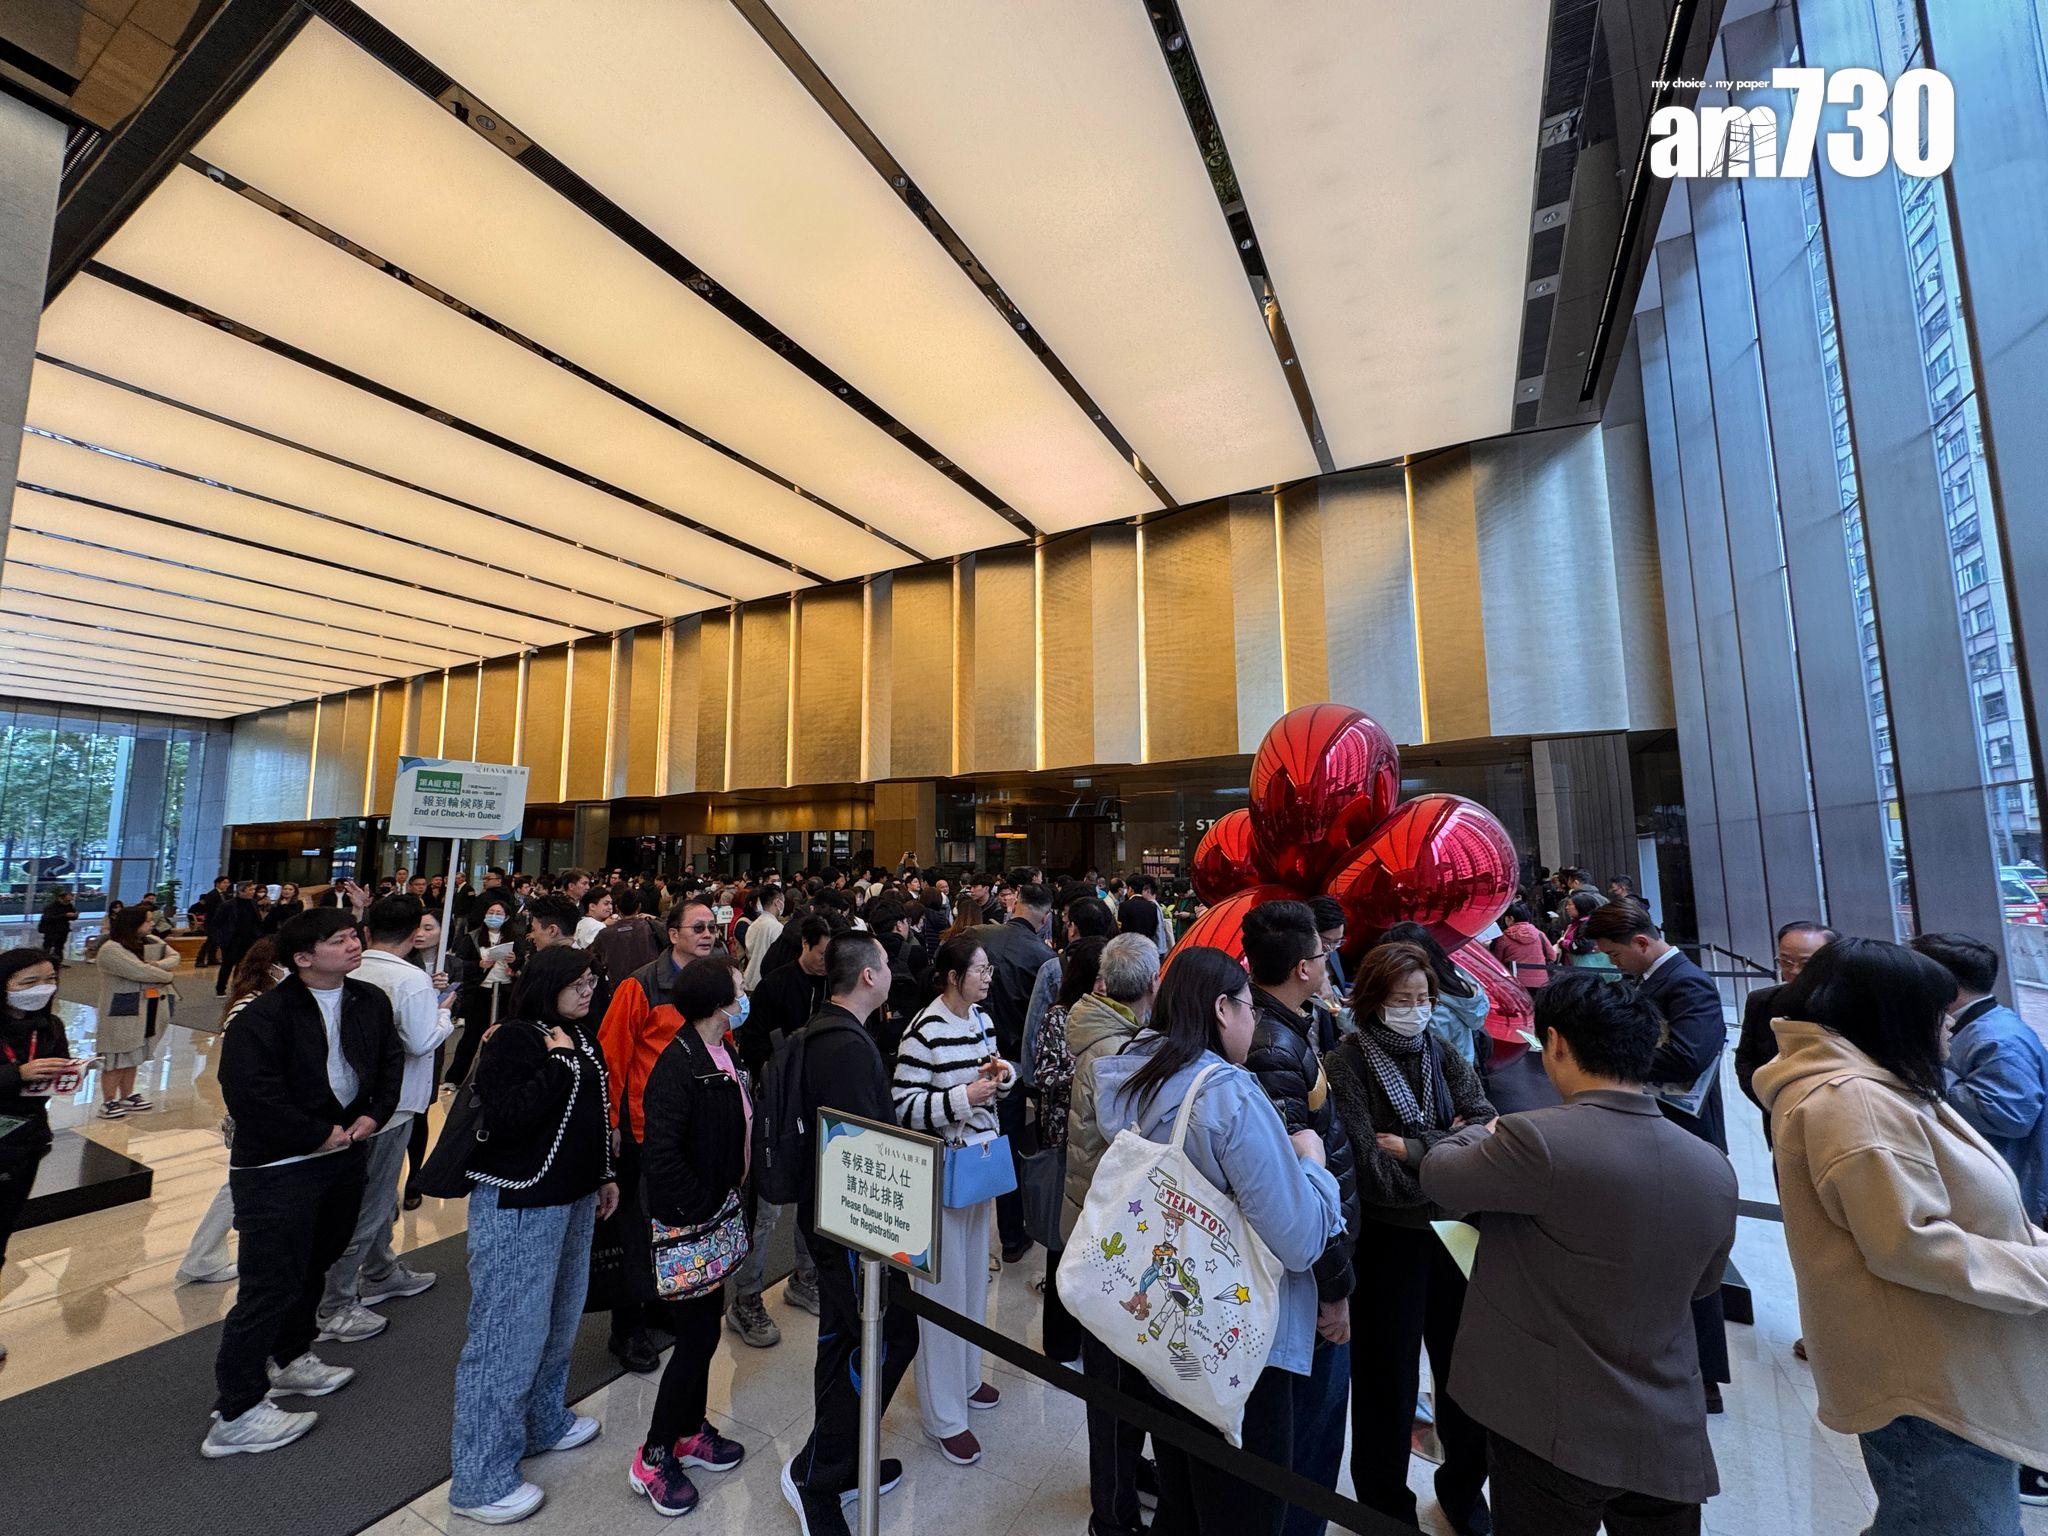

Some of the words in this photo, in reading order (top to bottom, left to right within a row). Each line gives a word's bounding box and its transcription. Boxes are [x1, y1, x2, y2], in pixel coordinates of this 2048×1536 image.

[413, 807, 429, 816] End
[431, 808, 440, 816] of
[441, 808, 475, 818] Check-in
[477, 811, 501, 820] Queue
[423, 795, 496, 811] 報到輪候隊尾
[841, 1150, 911, 1188] 等候登記人仕
[847, 1173, 904, 1210] 請於此排隊
[841, 1195, 861, 1212] Please
[863, 1203, 882, 1221] Queue
[884, 1211, 893, 1226] Up
[894, 1215, 910, 1231] Here
[850, 1213, 859, 1226] for
[860, 1217, 899, 1243] Registration
[1165, 1189, 1197, 1219] TEAM
[1200, 1210, 1226, 1237] TOY
